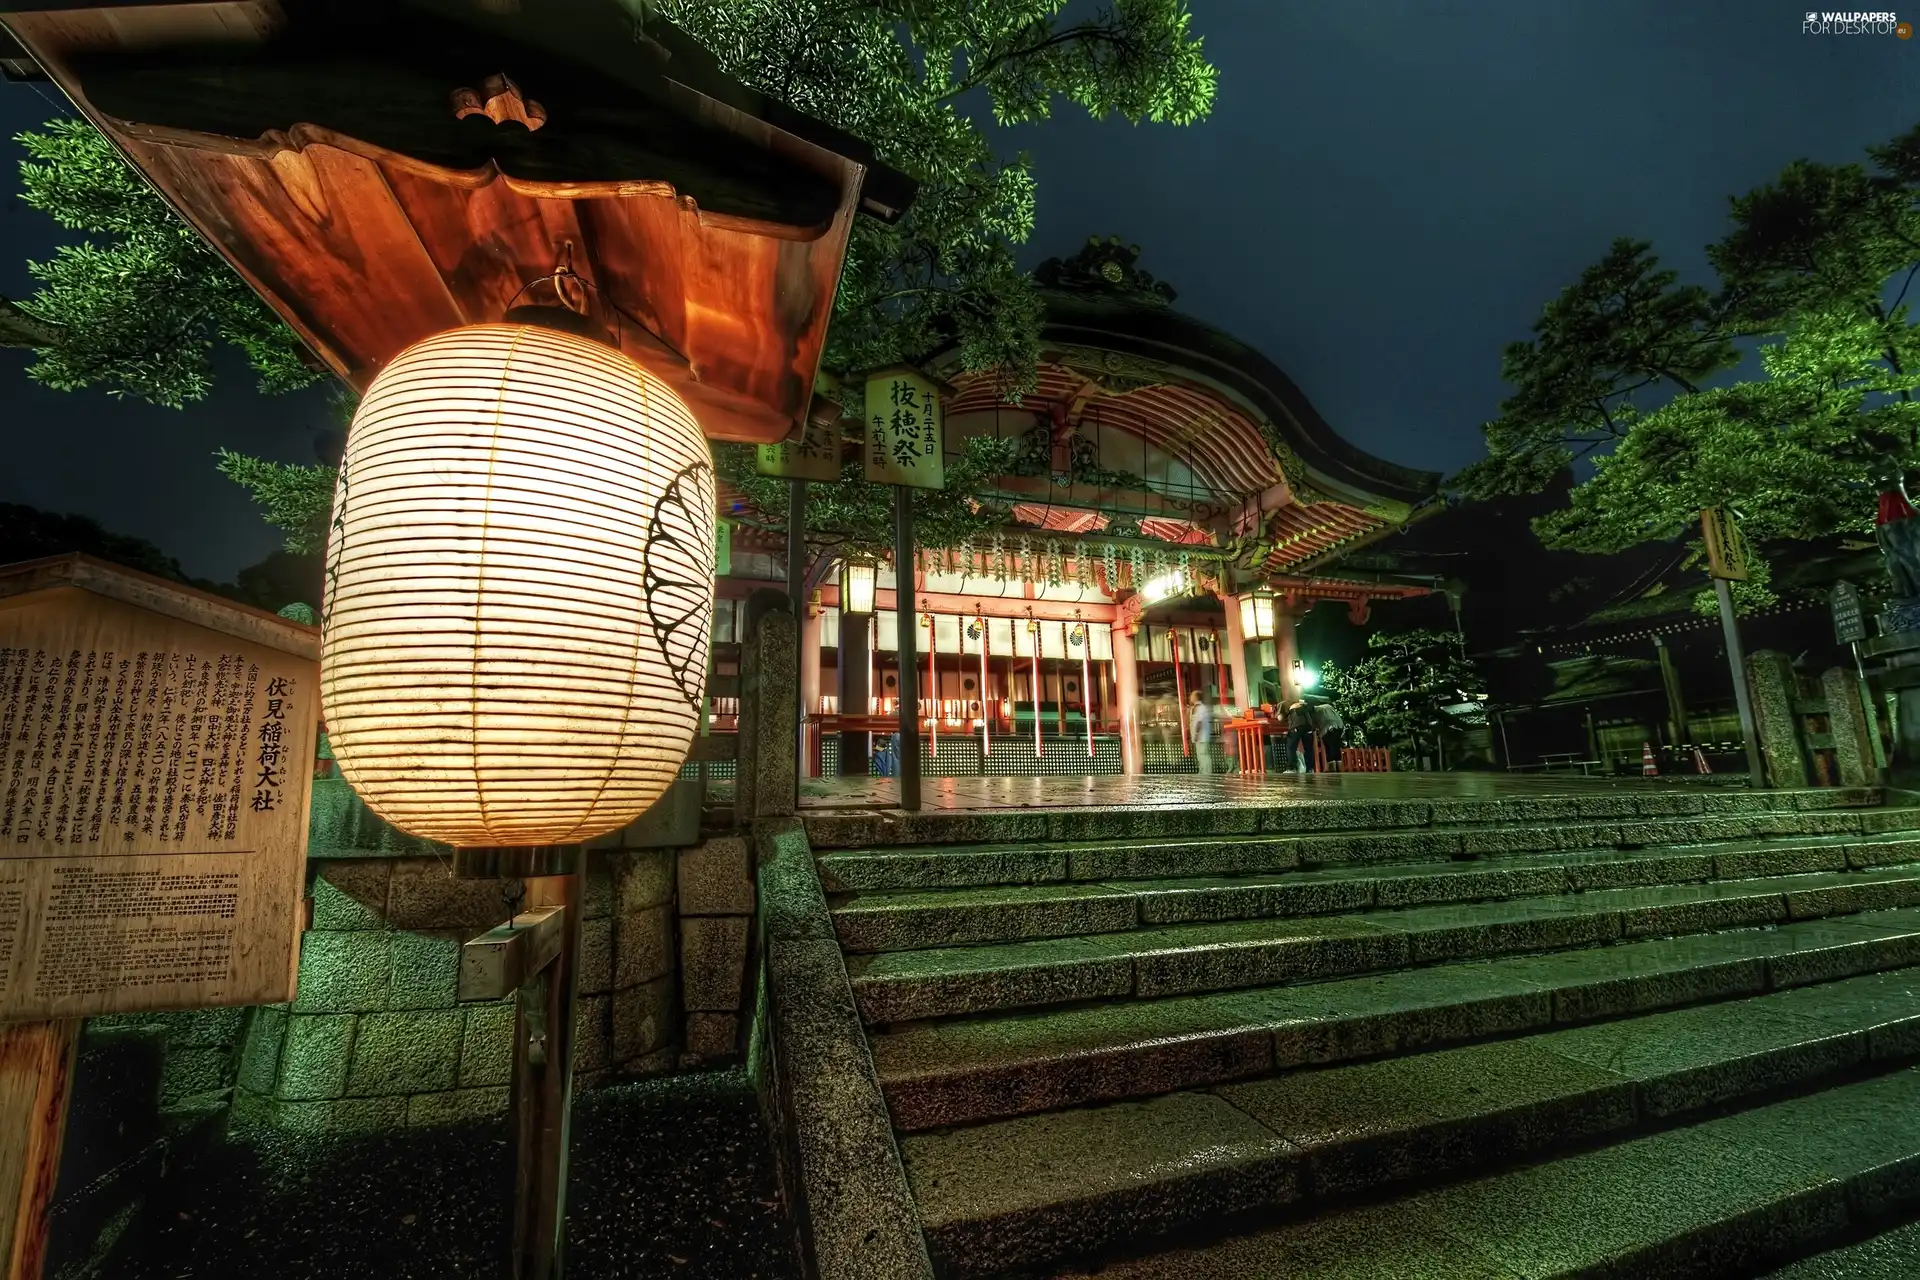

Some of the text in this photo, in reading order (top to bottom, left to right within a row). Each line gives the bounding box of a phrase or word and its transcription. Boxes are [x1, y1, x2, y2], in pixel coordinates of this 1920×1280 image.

[872, 415, 887, 471] 午前十一時
[889, 380, 922, 467] 抜穂祭
[922, 392, 936, 455] 十月二十五日
[249, 676, 288, 812] 伏見稲荷大社
